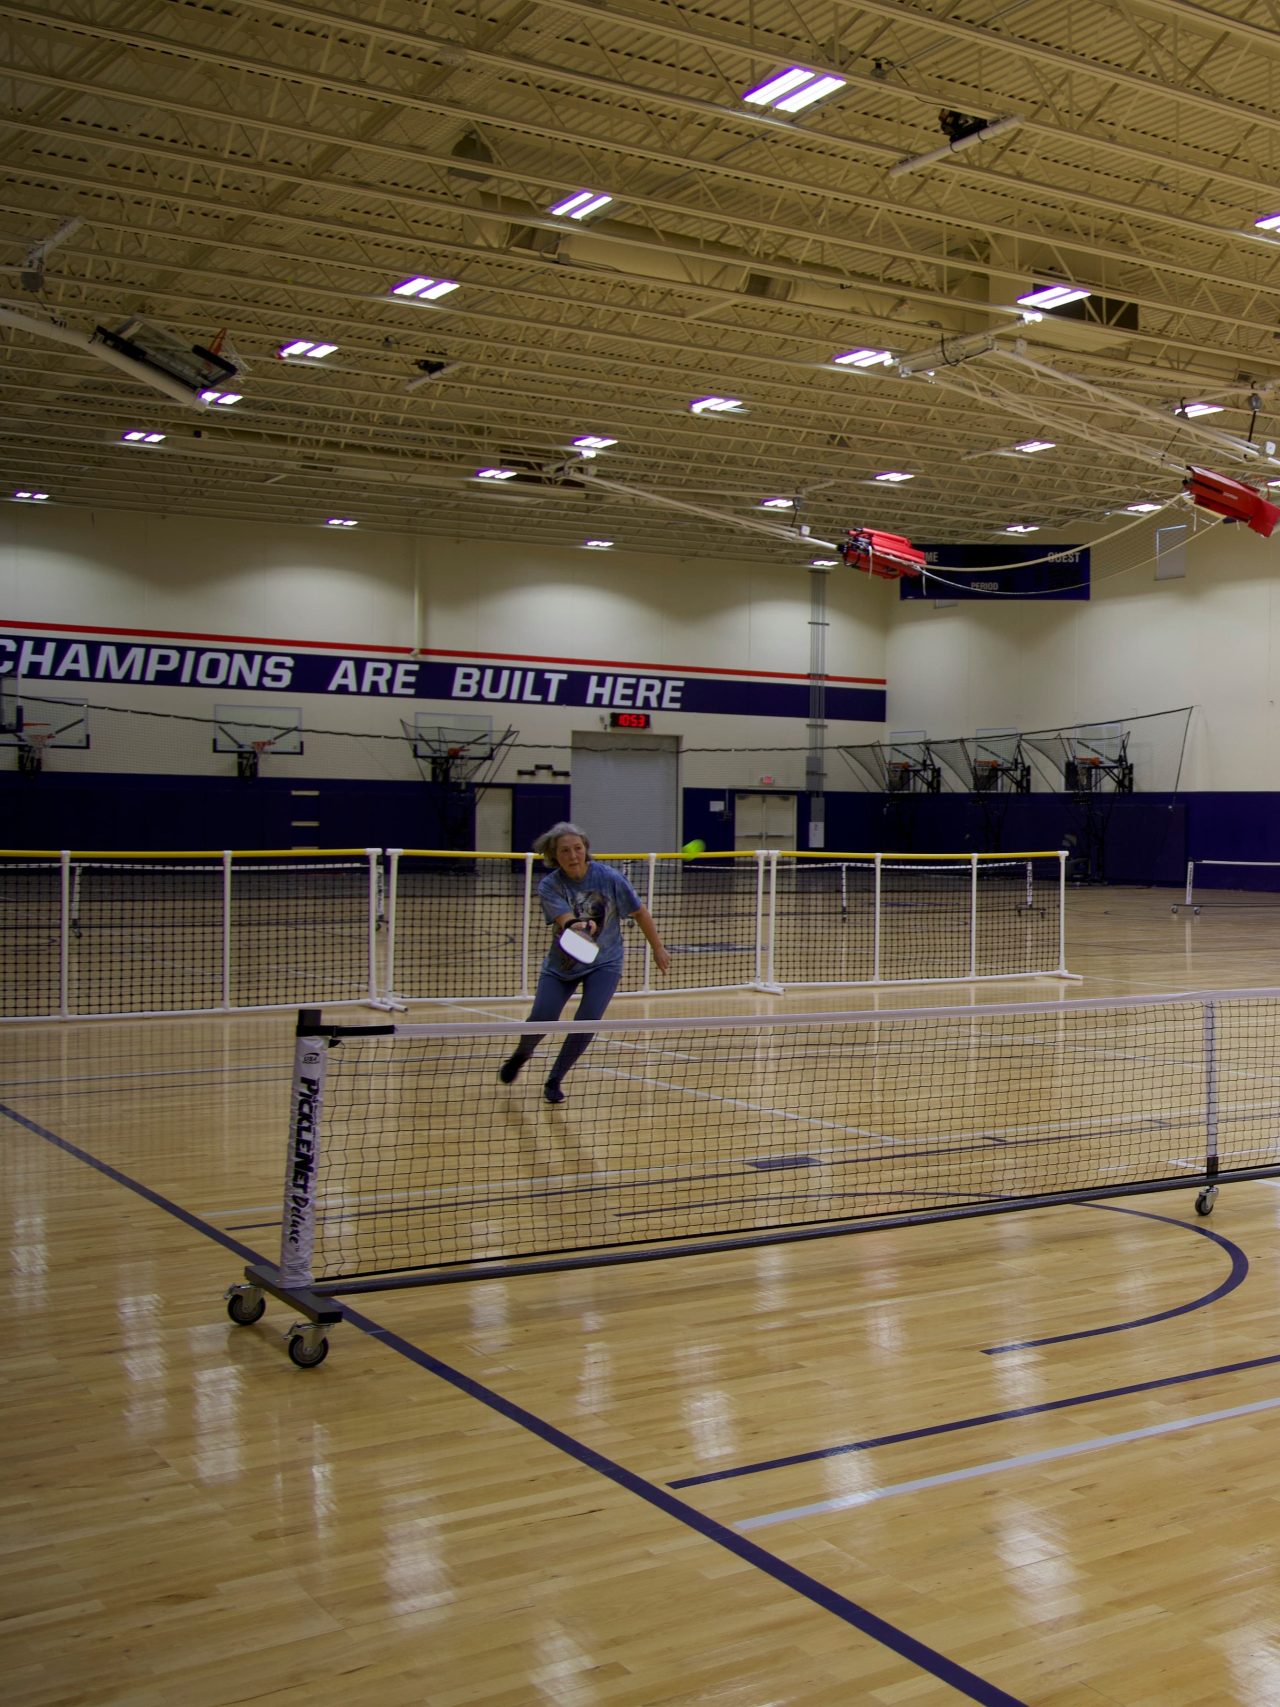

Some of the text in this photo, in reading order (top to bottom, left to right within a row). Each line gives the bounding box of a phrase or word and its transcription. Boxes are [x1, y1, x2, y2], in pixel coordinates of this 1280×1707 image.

[1047, 551, 1080, 564] GUEST
[971, 581, 999, 591] PERIOD
[328, 659, 420, 695] ARE
[451, 666, 567, 702] BUILT
[586, 674, 685, 710] HERE
